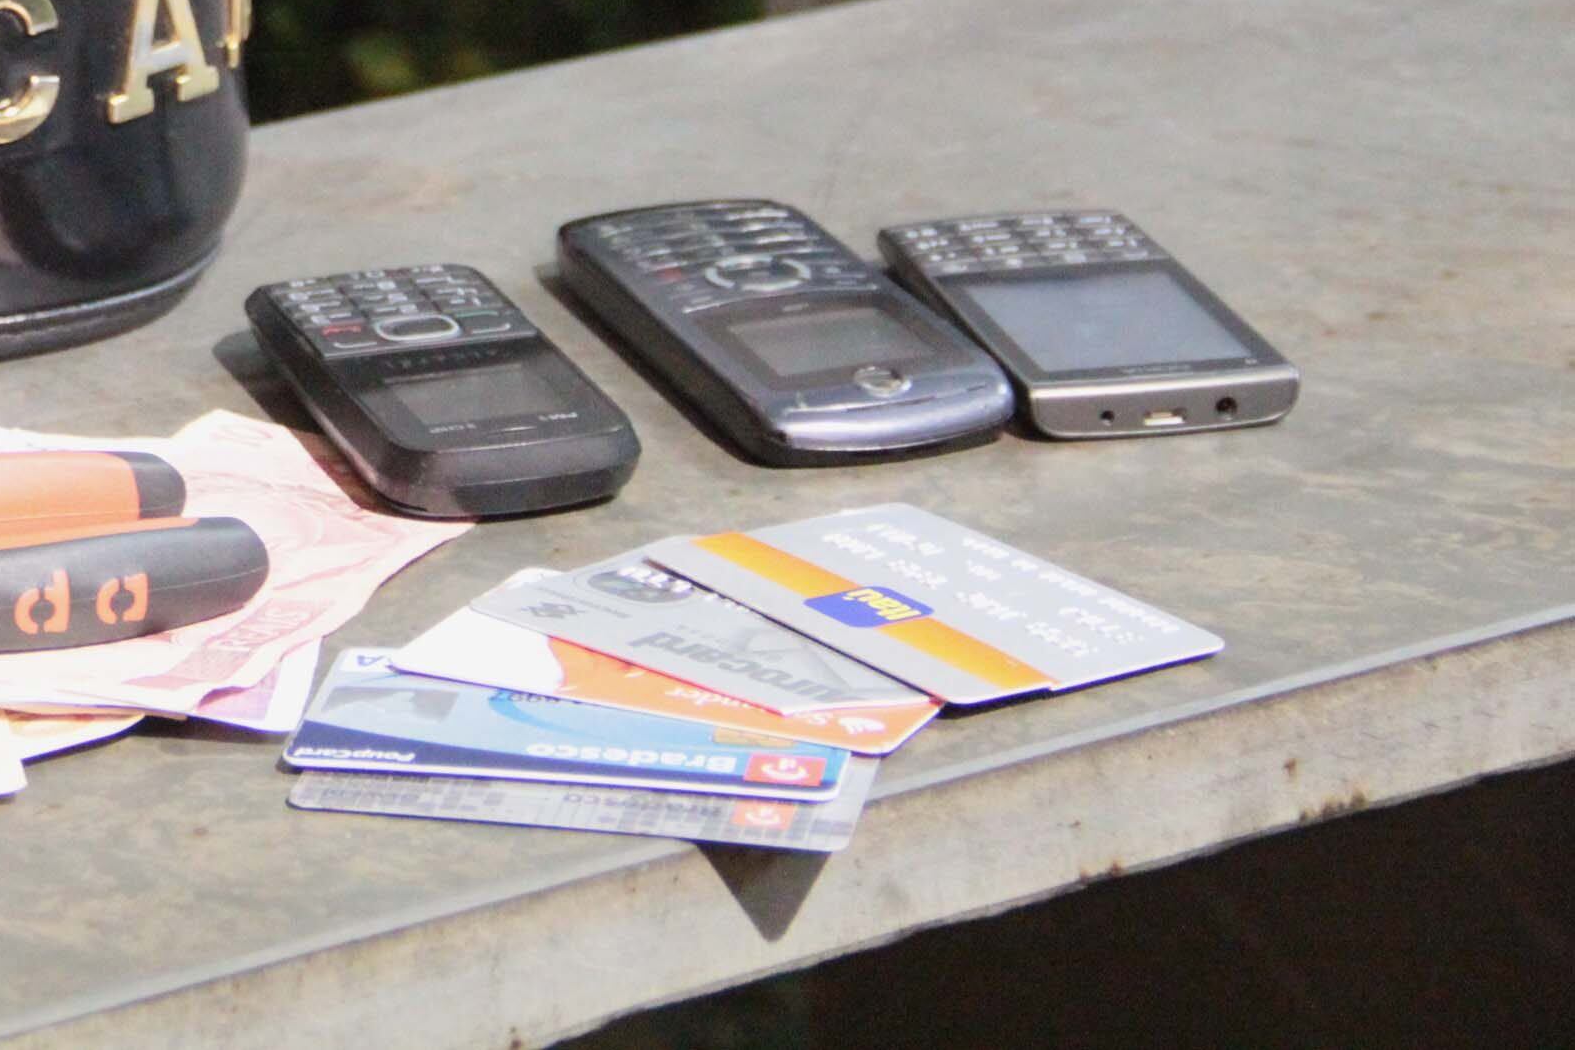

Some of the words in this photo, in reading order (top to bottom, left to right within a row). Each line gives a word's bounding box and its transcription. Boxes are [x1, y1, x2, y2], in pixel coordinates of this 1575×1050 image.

[846, 586, 922, 622] Itaú
[294, 746, 415, 763] PoupCard
[527, 743, 737, 773] Bradesco
